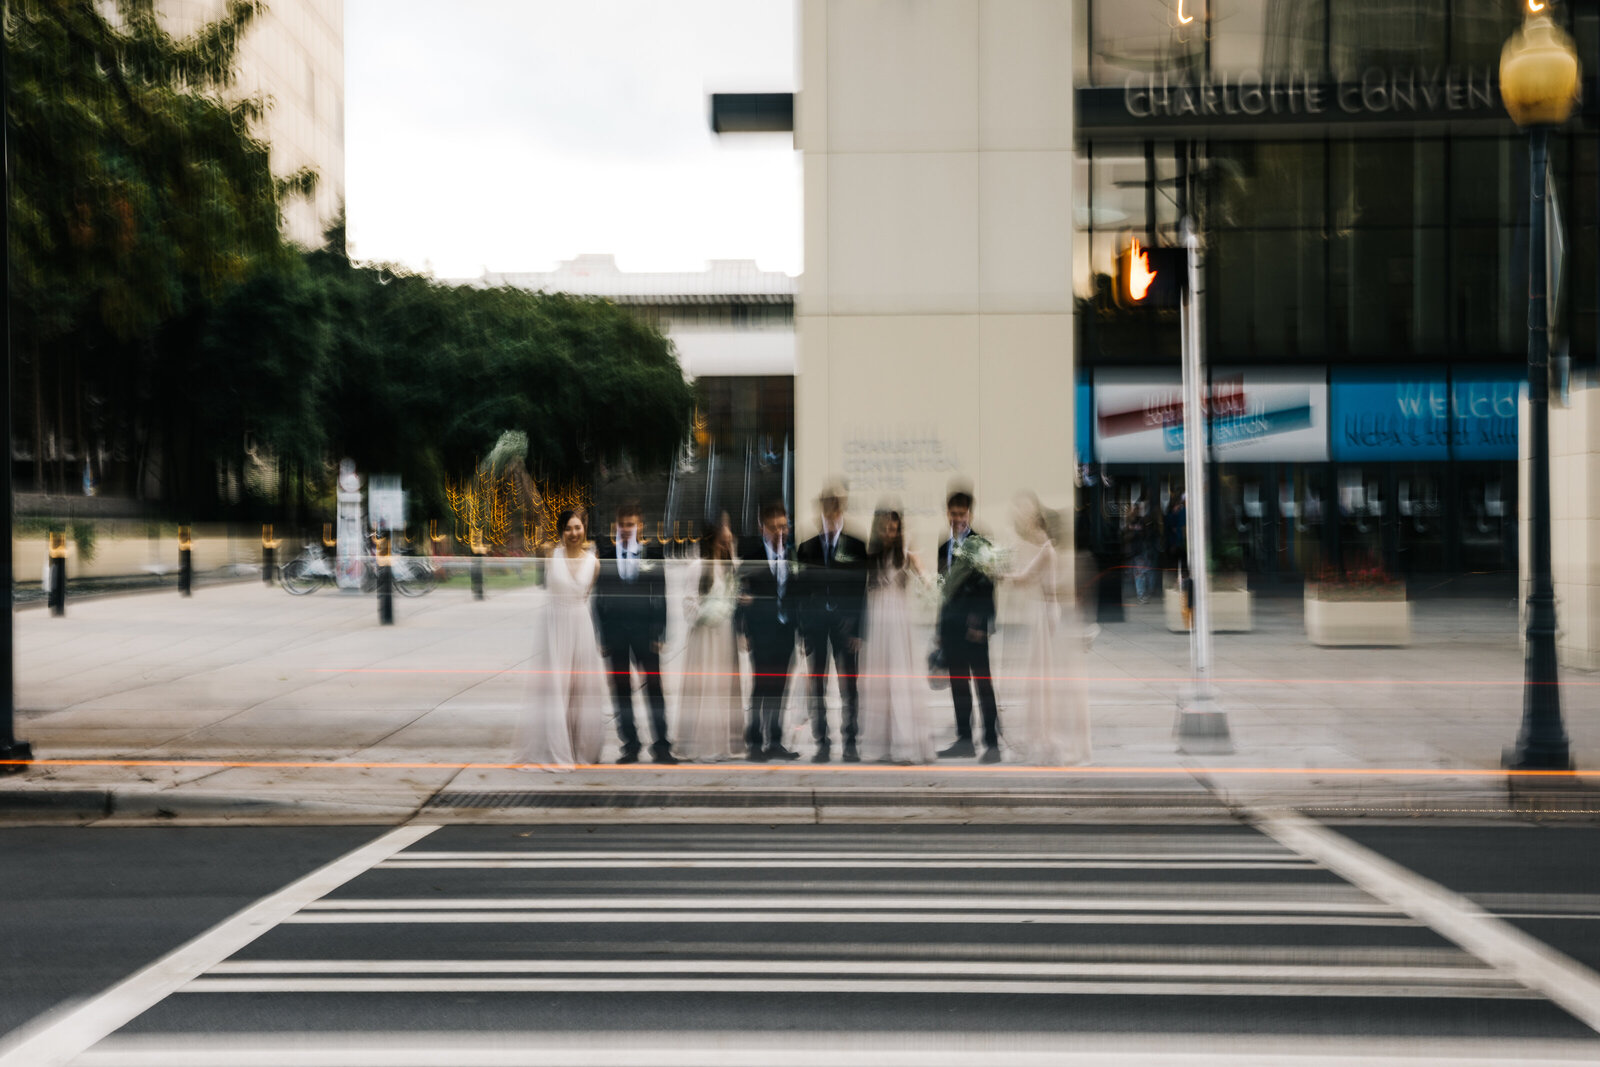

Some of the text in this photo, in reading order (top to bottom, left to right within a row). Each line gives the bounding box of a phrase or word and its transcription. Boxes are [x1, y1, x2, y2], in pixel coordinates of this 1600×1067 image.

[1125, 67, 1495, 118] CHARLOTTE CONVEN
[1398, 380, 1517, 419] WELCO
